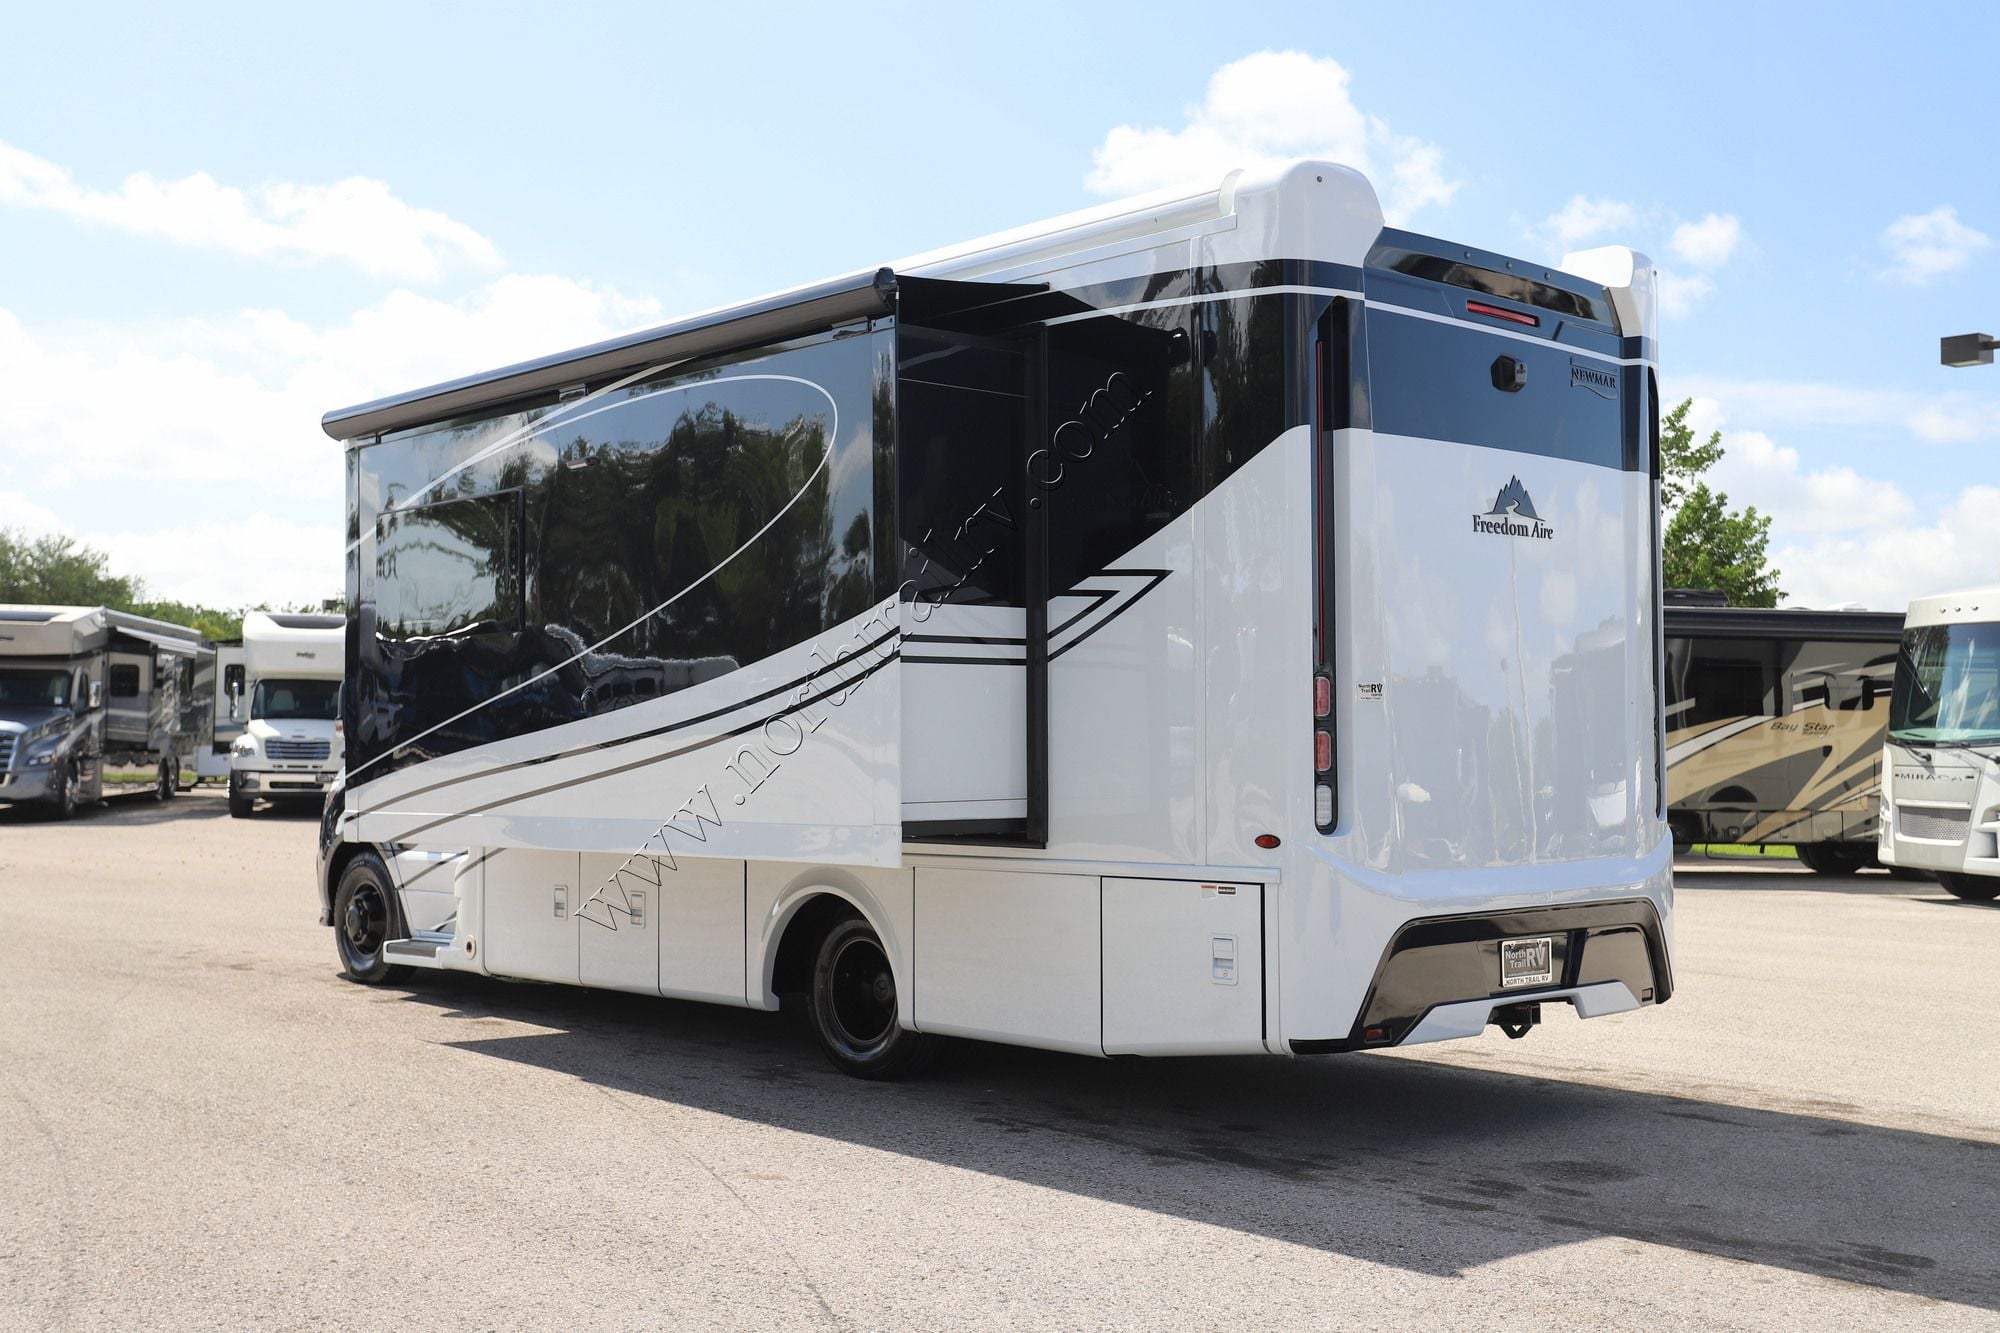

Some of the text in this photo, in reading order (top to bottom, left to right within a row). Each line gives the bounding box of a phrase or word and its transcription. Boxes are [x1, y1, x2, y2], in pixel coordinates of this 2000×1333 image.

[1571, 367, 1617, 389] NEWMAR
[1472, 514, 1554, 540] Freedom Aire
[1770, 721, 1835, 733] Bay Star
[1505, 947, 1546, 967] North RV
[1510, 959, 1527, 969] Trail
